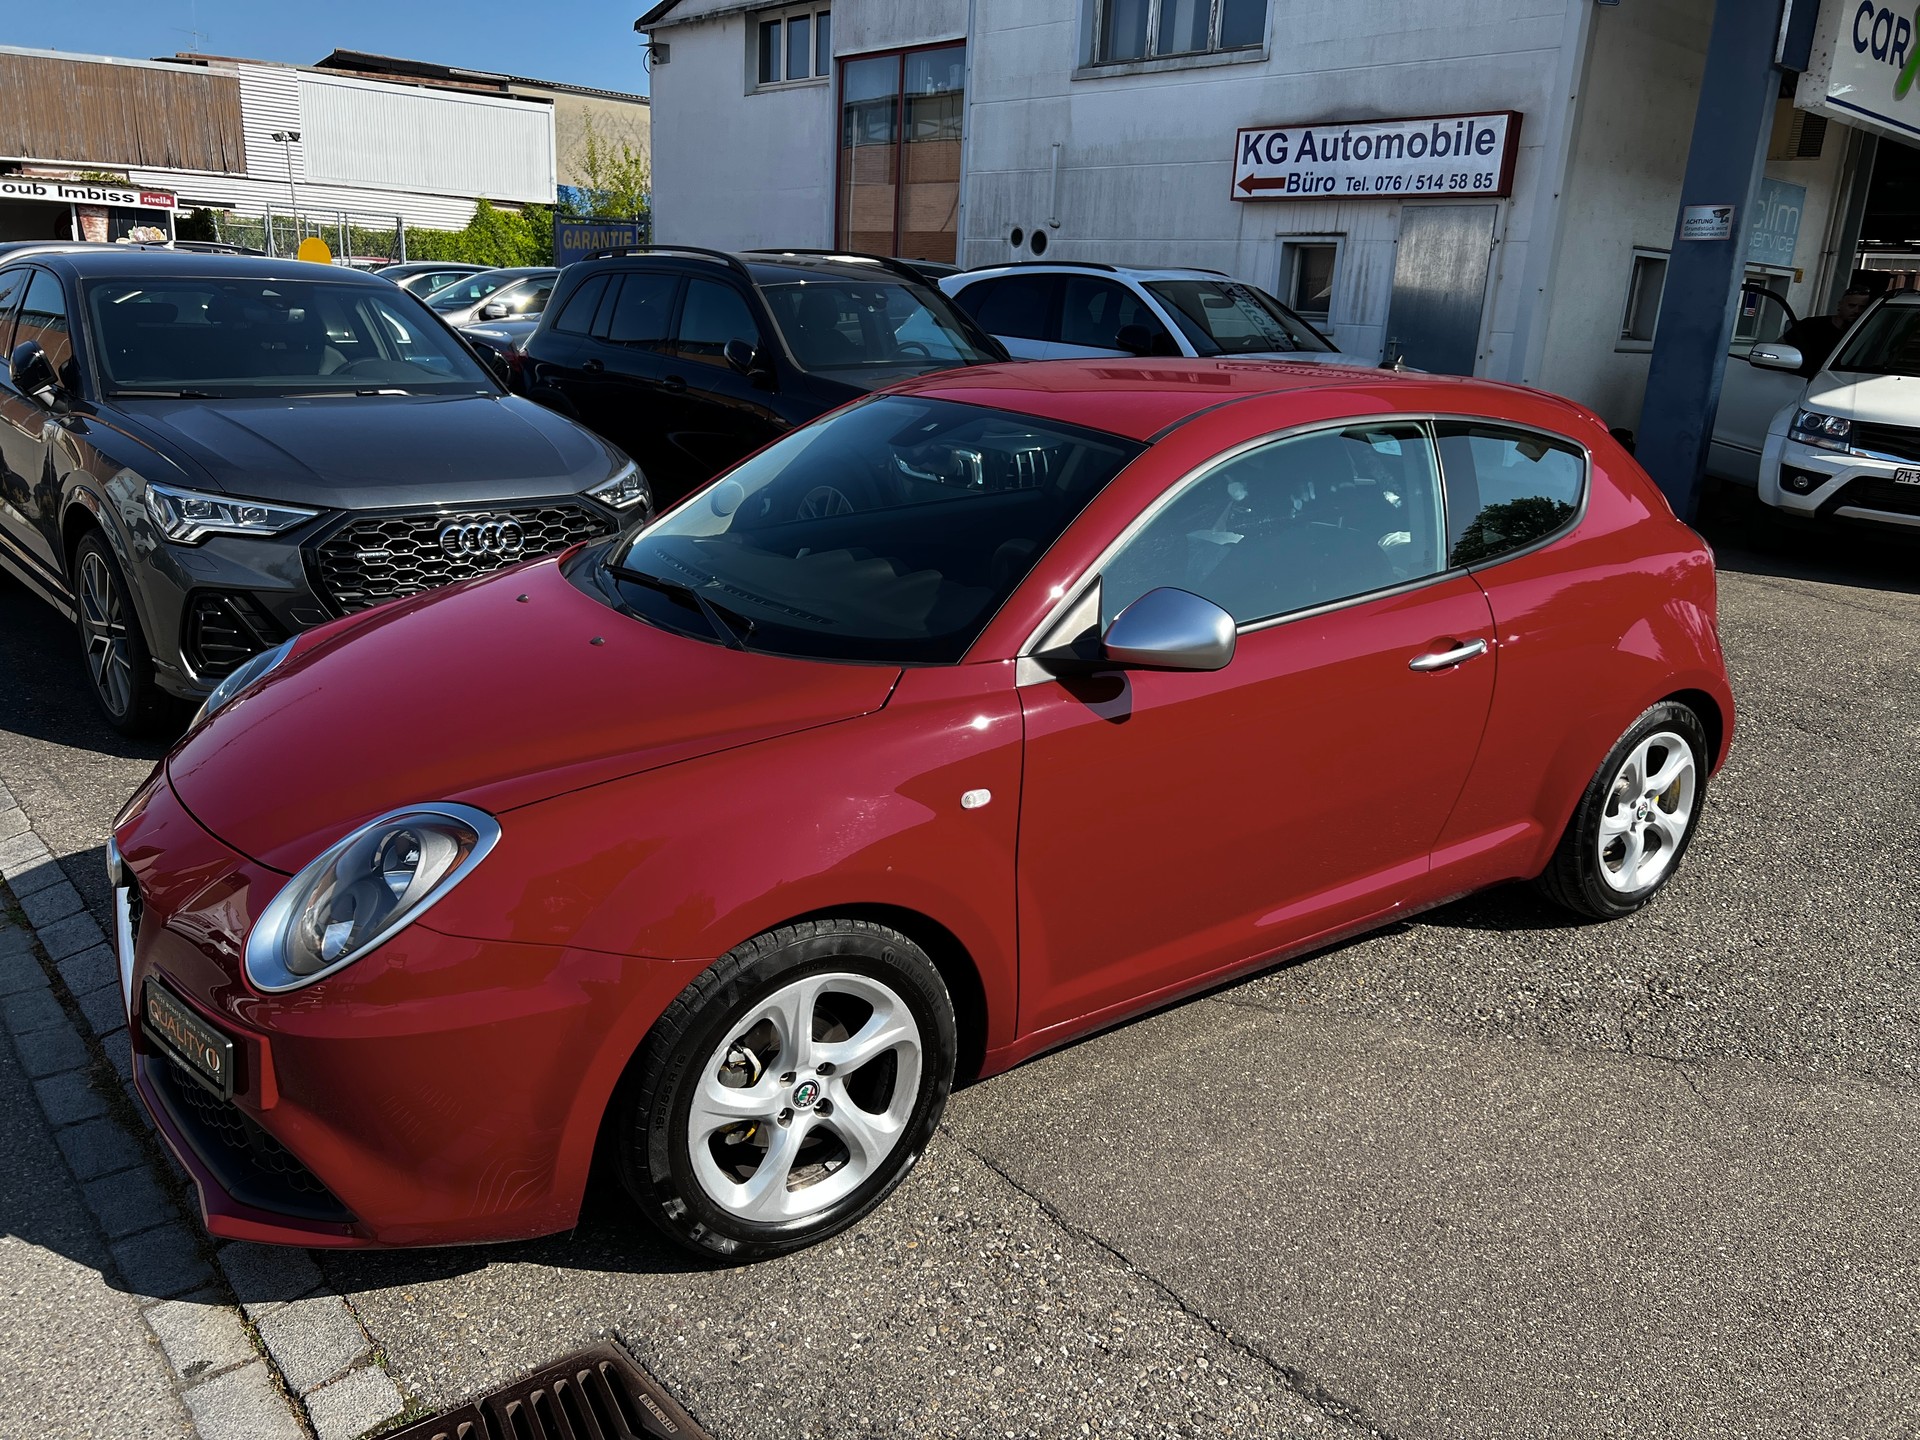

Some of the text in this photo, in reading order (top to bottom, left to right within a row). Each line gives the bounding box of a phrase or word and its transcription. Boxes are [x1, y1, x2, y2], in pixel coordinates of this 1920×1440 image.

[1242, 121, 1496, 165] KG Automobile
[1286, 172, 1336, 193] Büro
[1345, 176, 1370, 192] Tel.
[1375, 175, 1401, 191] 076
[1415, 174, 1443, 190] 514
[1449, 173, 1468, 189] 58
[1473, 172, 1493, 189] 85
[57, 185, 135, 203] Imbiss
[144, 196, 172, 206] rivella
[563, 229, 633, 249] GARANTIE
[150, 1000, 205, 1058] QUALITY
